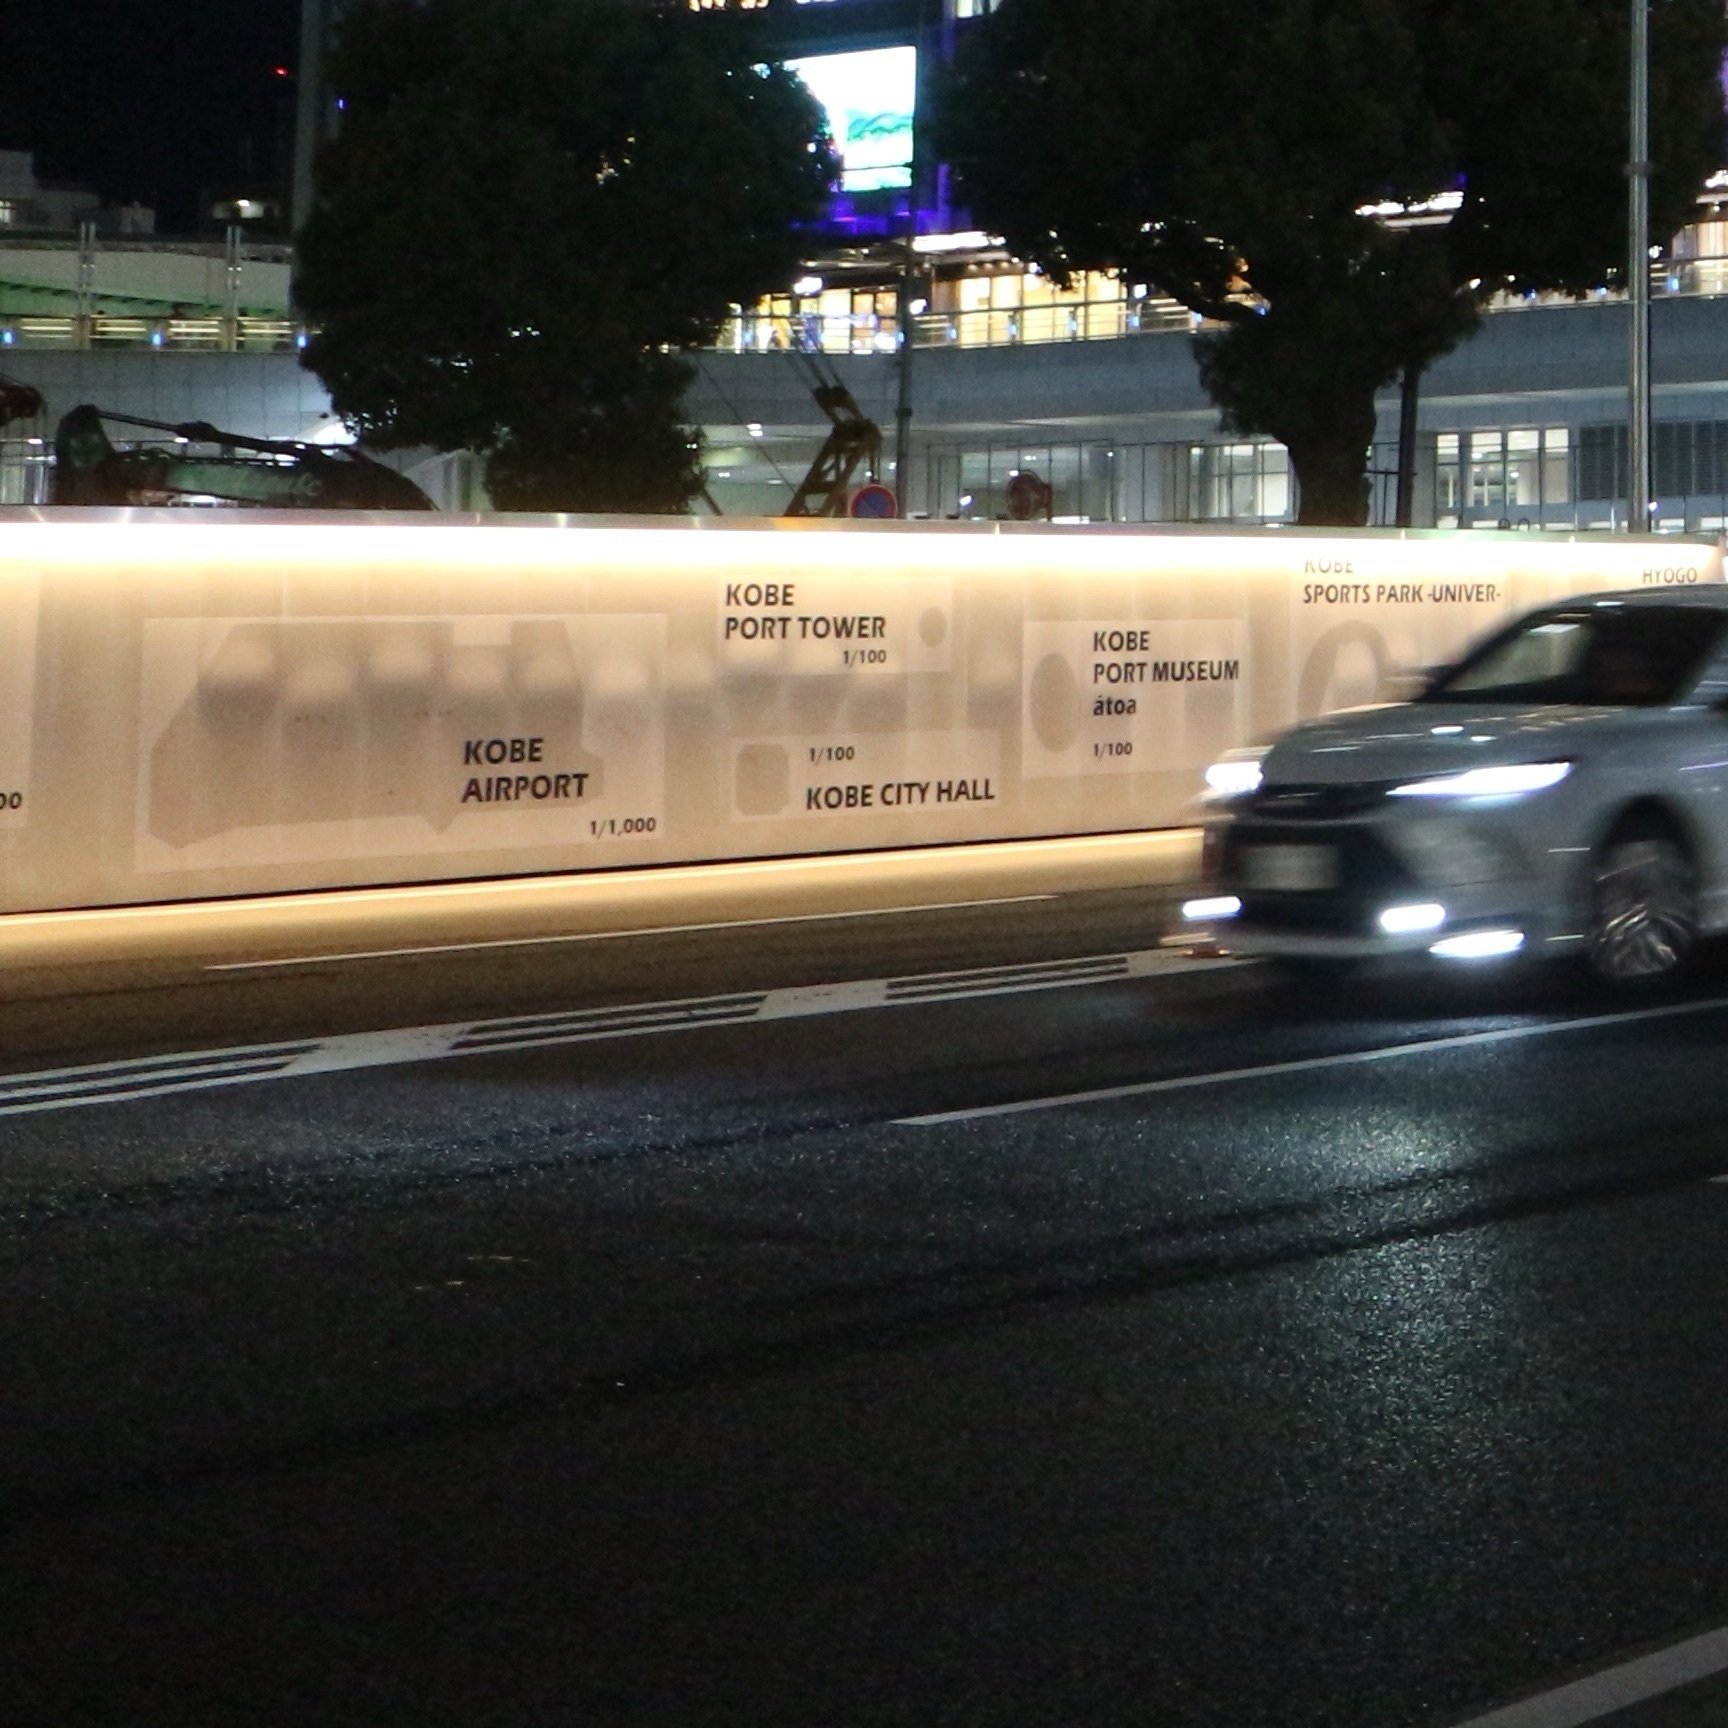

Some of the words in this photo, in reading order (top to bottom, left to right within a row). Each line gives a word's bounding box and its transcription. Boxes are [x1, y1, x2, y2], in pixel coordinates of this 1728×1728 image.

[725, 583, 795, 608] KOBE
[1303, 583, 1371, 604] SPORTS
[1376, 583, 1424, 603] PARK
[725, 616, 791, 641] PORT
[798, 615, 886, 640] TOWER
[1093, 630, 1151, 652] KOBE
[842, 649, 887, 667] 1/100
[1093, 662, 1147, 684] PORT
[1152, 659, 1239, 683] MUSEUM
[463, 737, 543, 766] KOBE
[808, 745, 855, 764] 1/100
[1093, 742, 1133, 760] 1/100
[461, 773, 590, 803] AIRPORT
[805, 783, 874, 812] KOBE
[880, 781, 931, 808] CITY
[936, 777, 995, 804] HALL
[589, 817, 657, 841] 1/1,000
